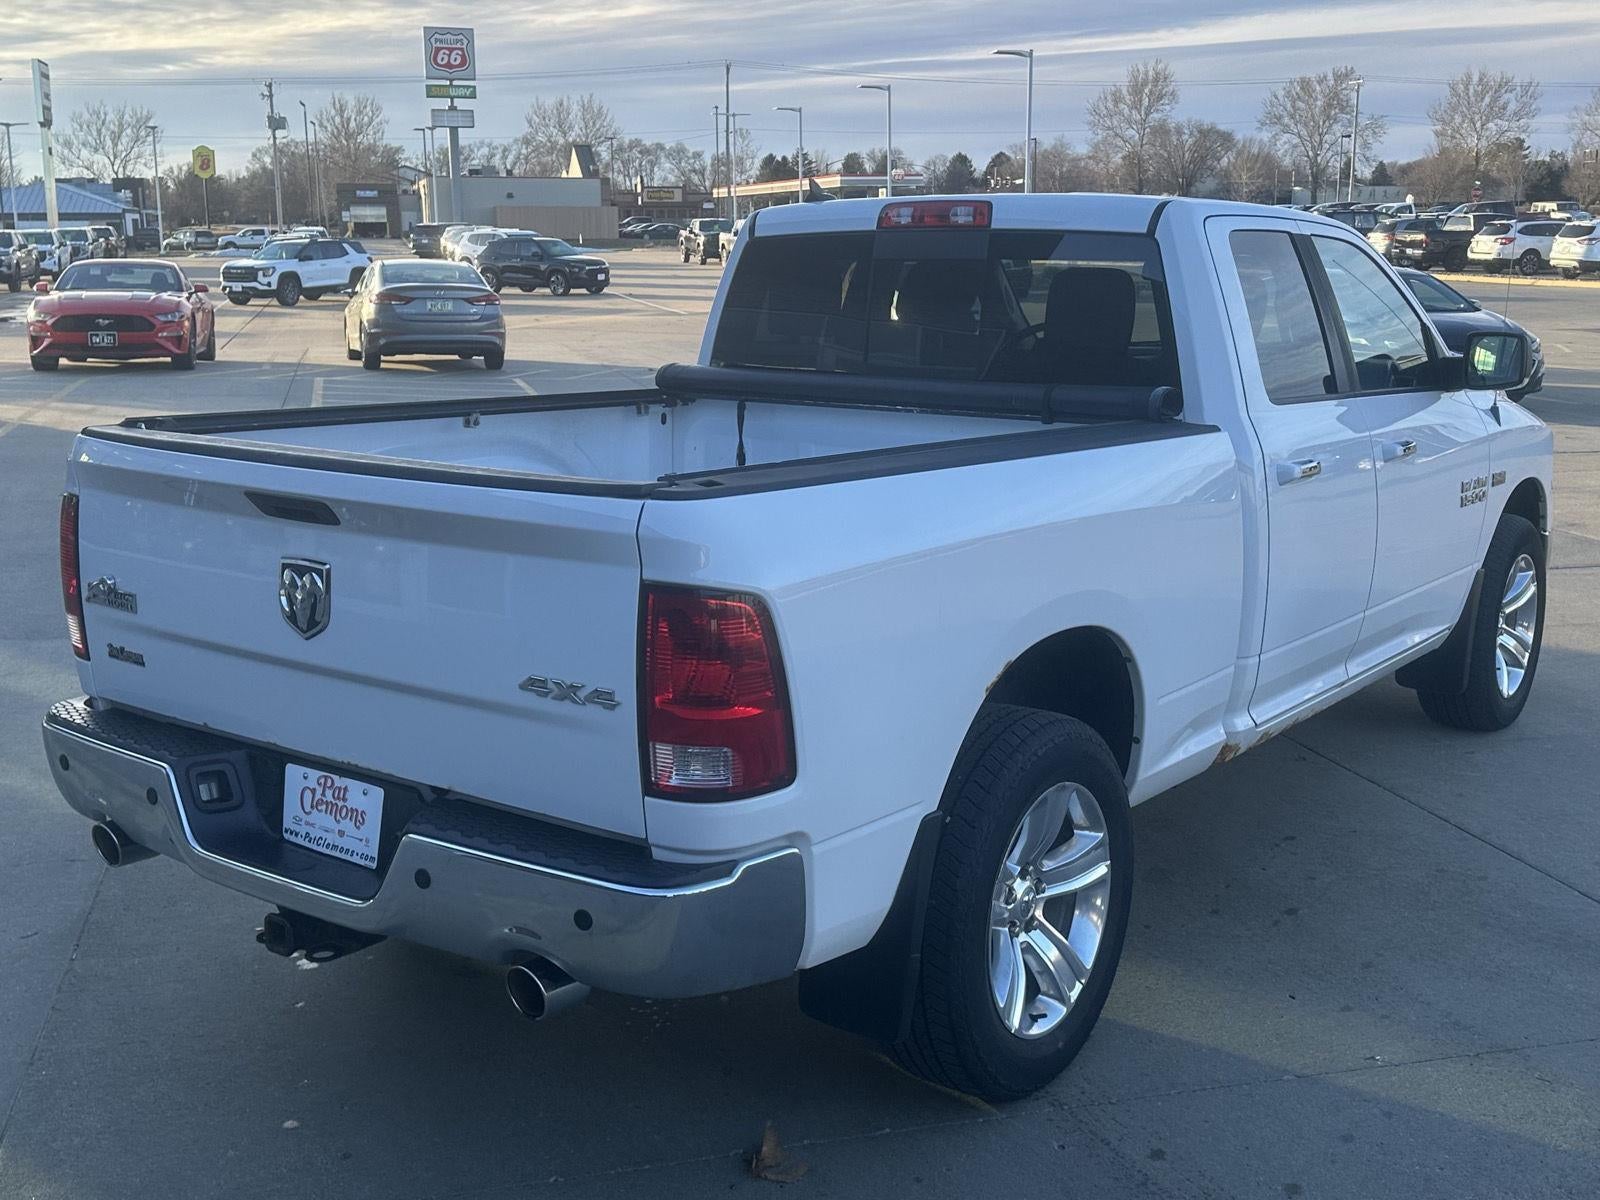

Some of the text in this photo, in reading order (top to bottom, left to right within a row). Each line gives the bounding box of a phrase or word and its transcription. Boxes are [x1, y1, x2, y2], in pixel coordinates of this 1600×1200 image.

[434, 37, 465, 46] PHILLIPS
[437, 49, 462, 65] 66
[317, 774, 349, 803] Pat
[300, 785, 367, 831] Clemons
